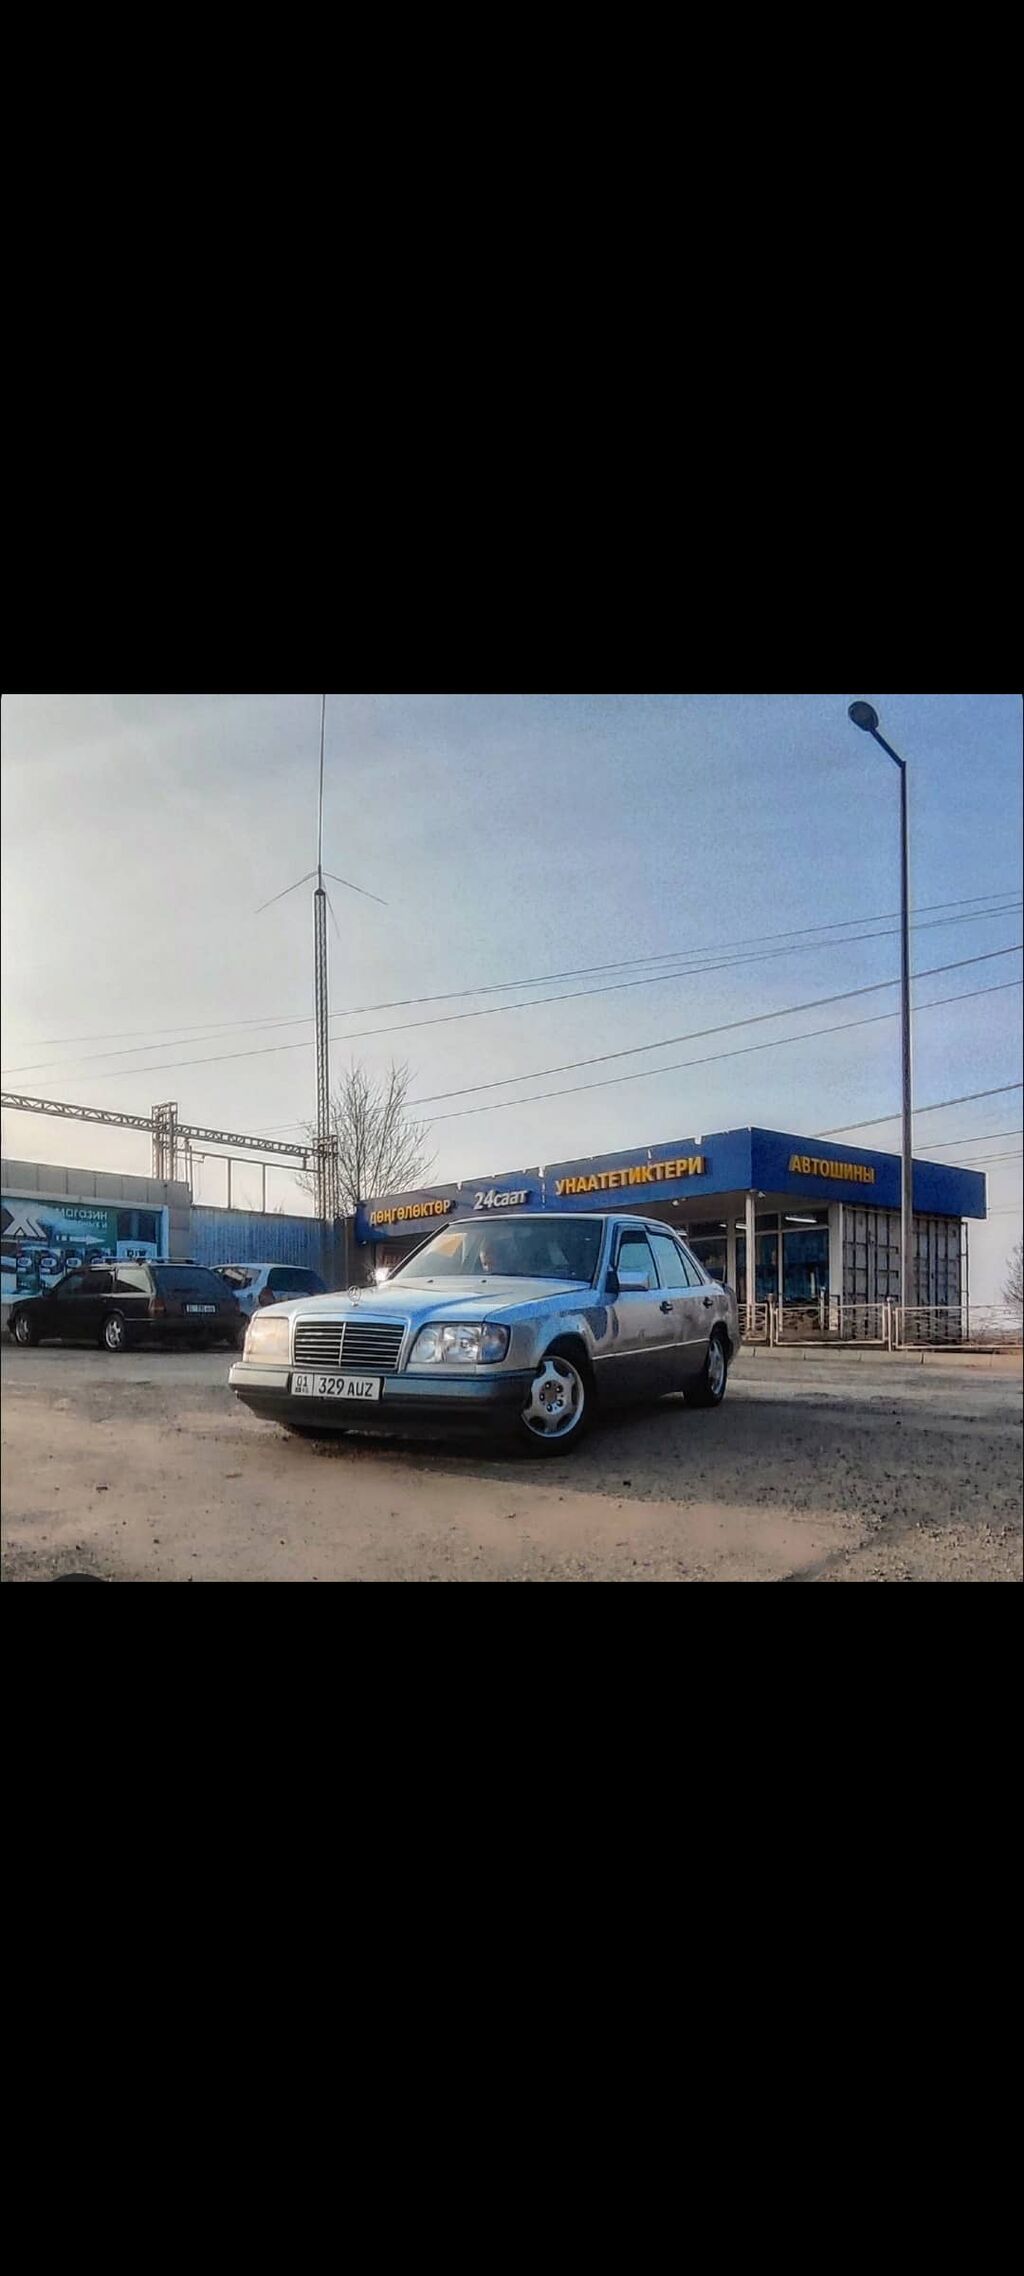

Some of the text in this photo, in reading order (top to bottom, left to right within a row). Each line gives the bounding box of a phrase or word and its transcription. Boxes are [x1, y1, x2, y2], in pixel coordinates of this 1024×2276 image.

[555, 1156, 703, 1196] УНААТЕТИКТЕРИ
[788, 1155, 876, 1185] АВТОШИНЫ
[473, 1189, 528, 1210] 24саат
[296, 1375, 308, 1387] 01
[318, 1377, 373, 1397] 329 AUZ
